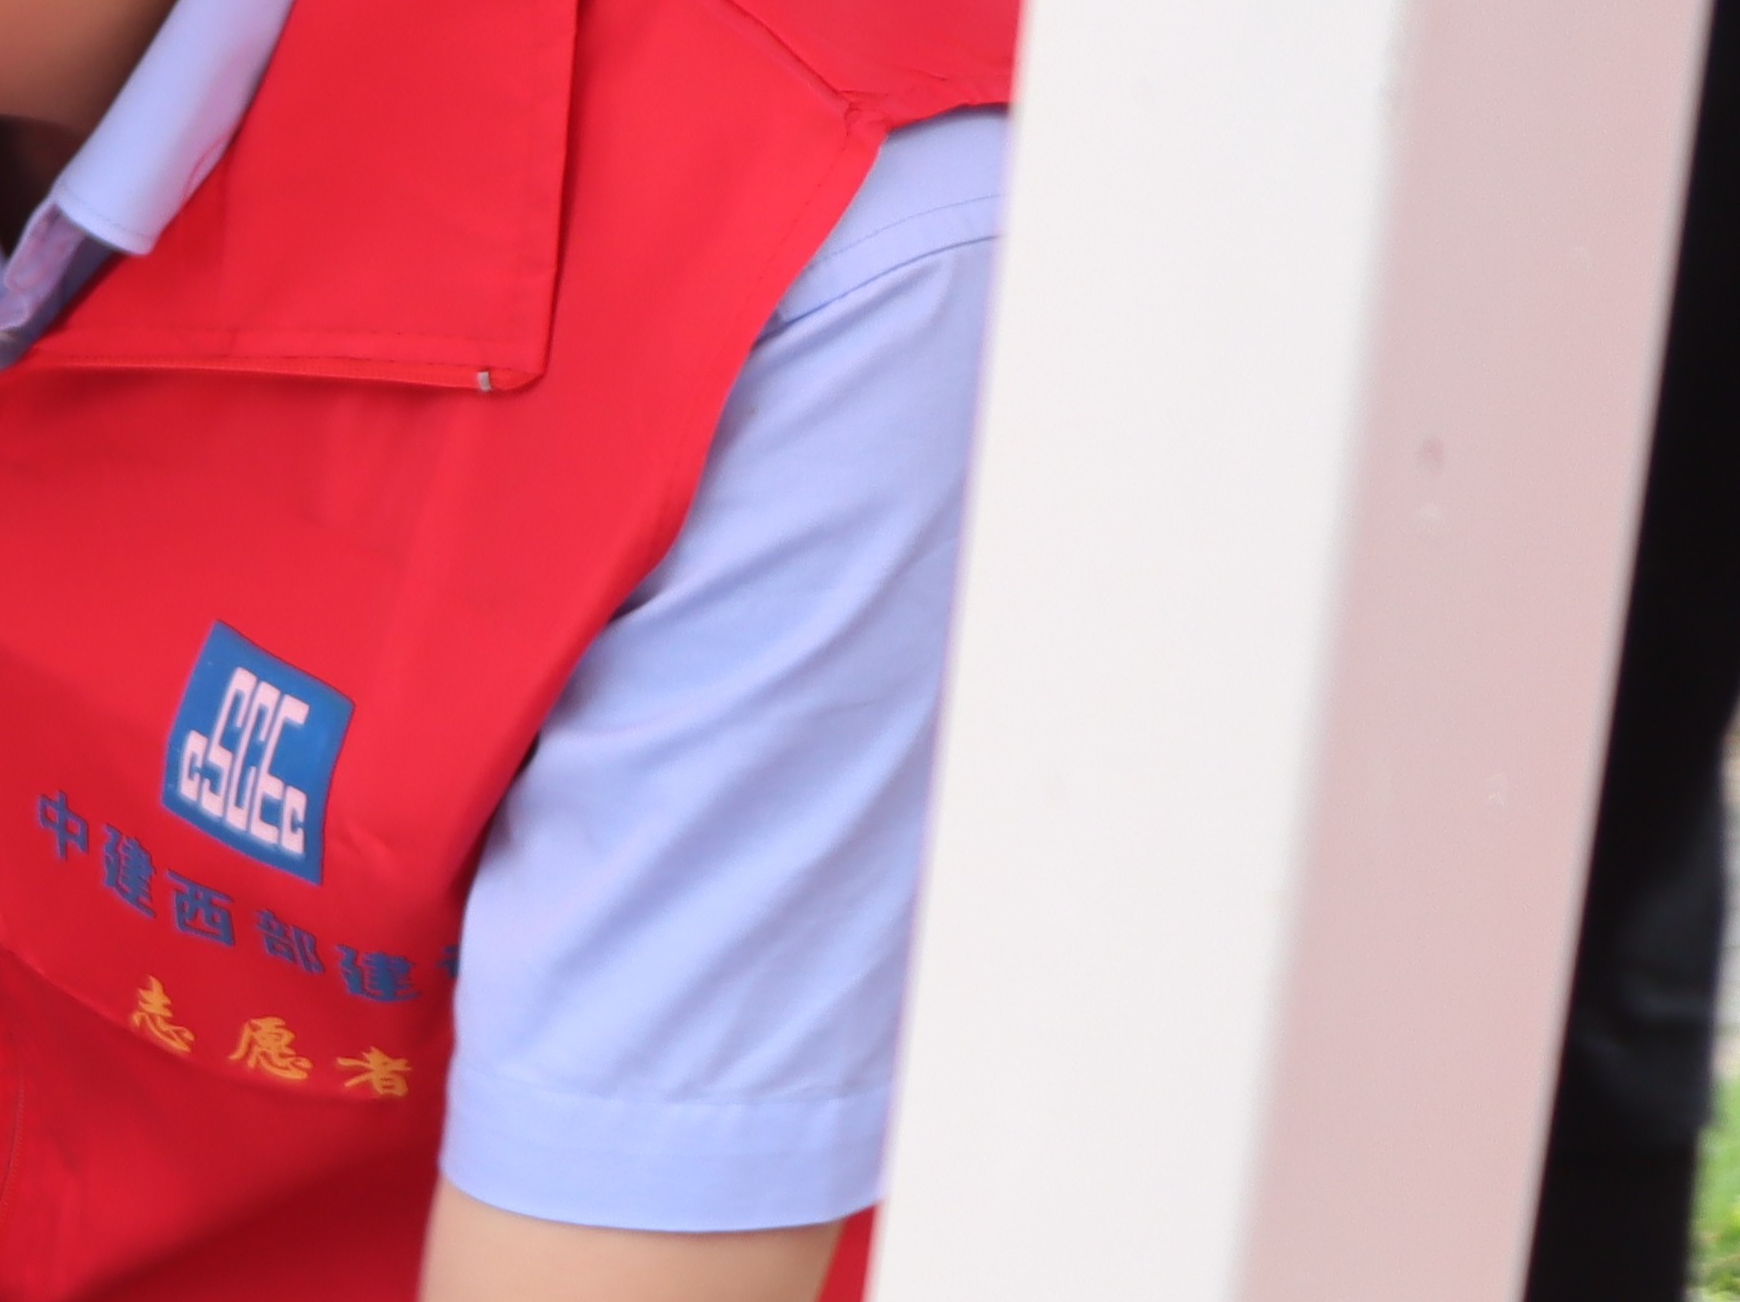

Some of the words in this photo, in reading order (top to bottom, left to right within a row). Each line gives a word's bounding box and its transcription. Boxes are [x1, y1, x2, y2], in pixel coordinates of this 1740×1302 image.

[177, 665, 311, 856] CSCEC
[36, 789, 460, 1002] 中建西部建
[130, 973, 413, 1098] 志愿者
